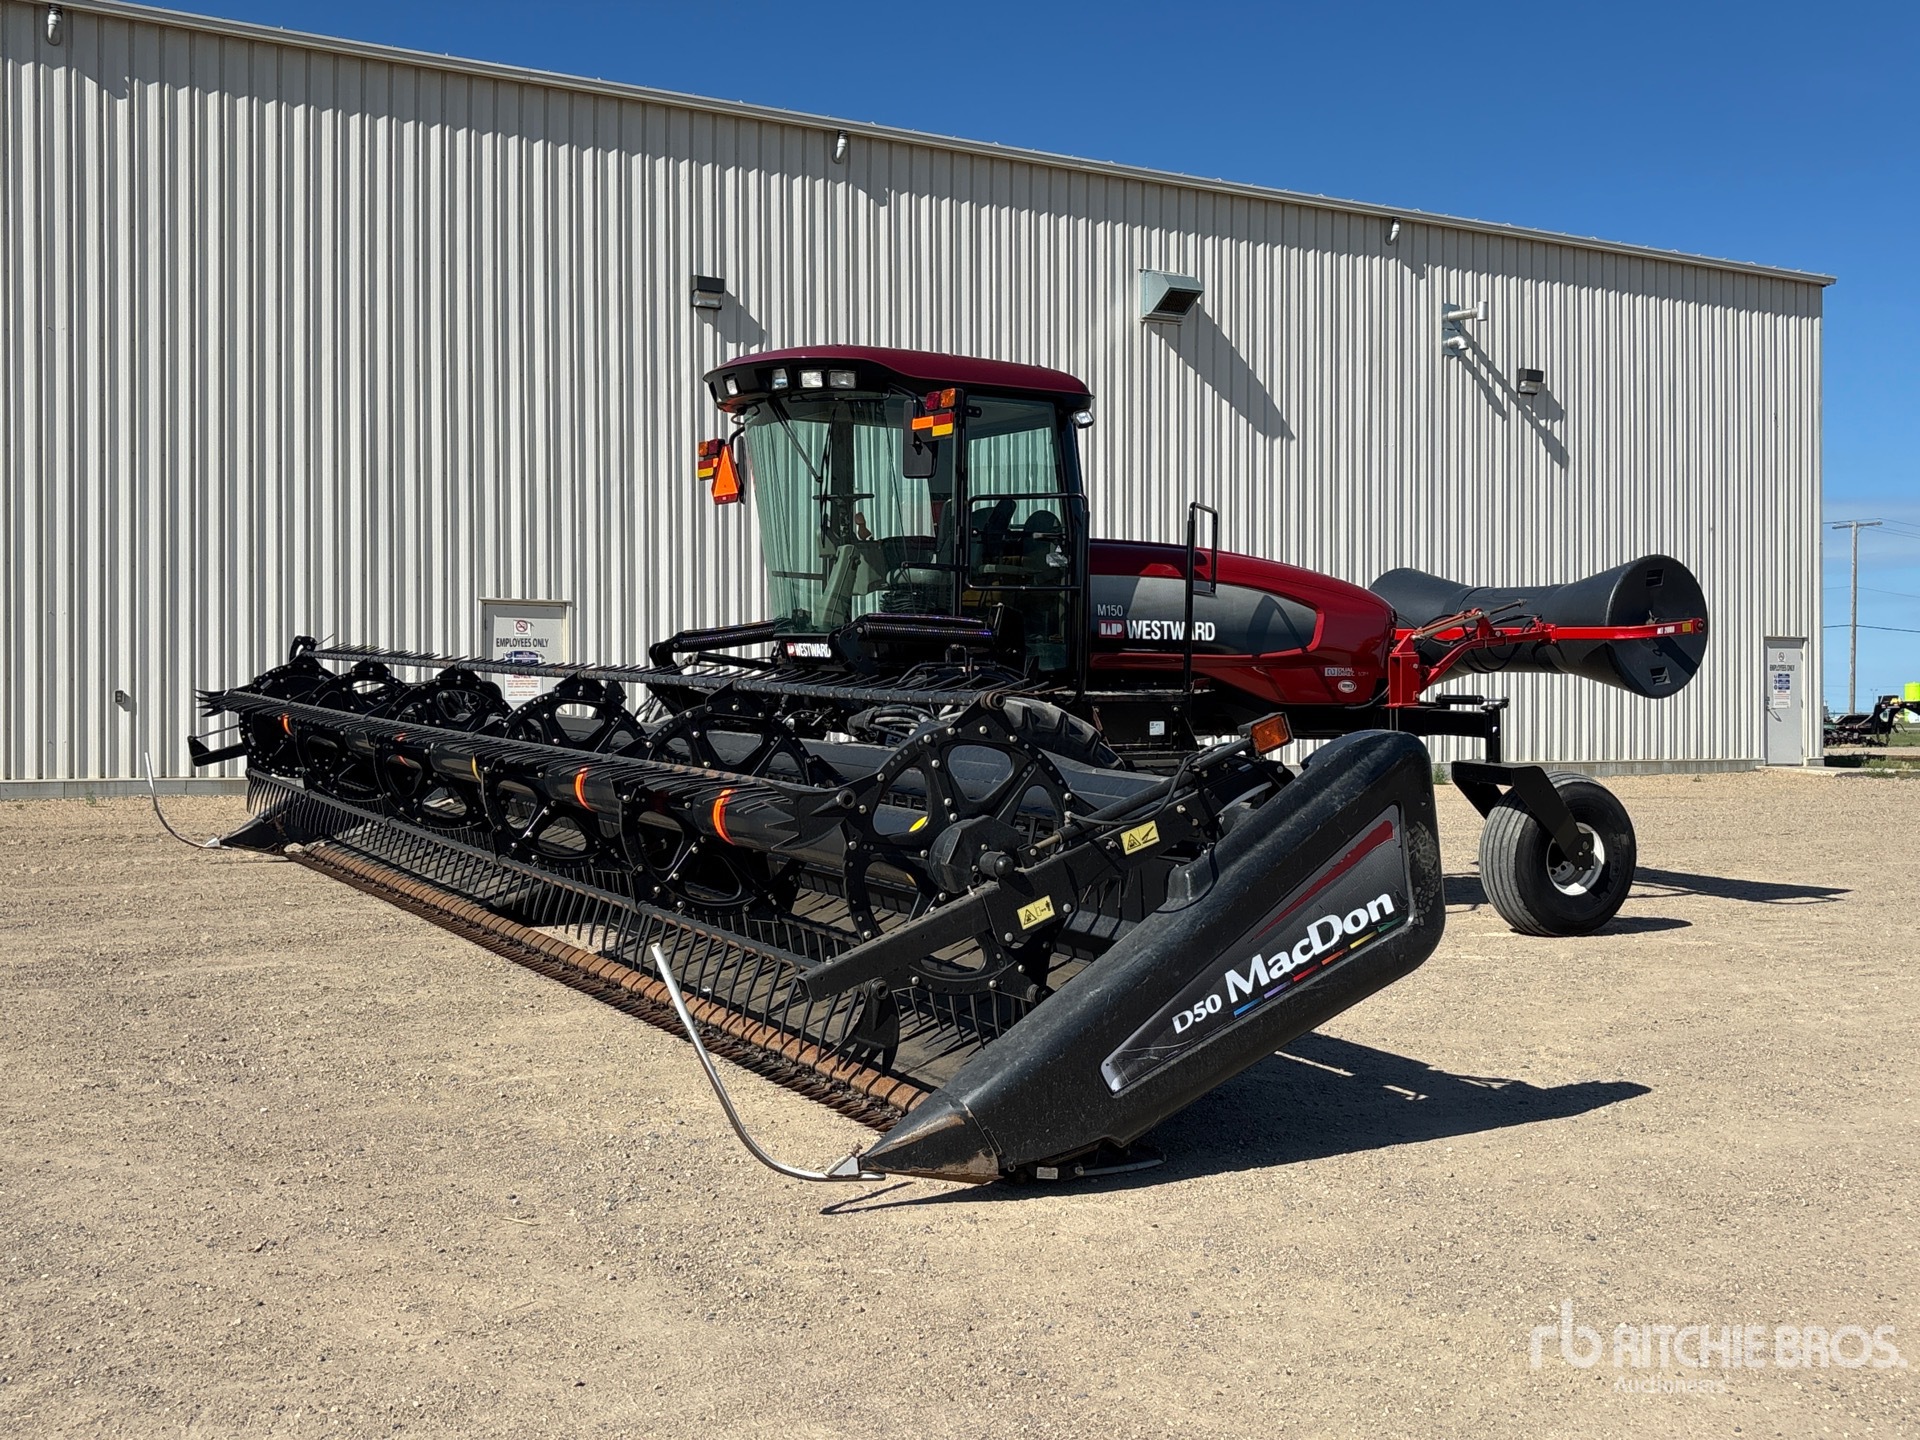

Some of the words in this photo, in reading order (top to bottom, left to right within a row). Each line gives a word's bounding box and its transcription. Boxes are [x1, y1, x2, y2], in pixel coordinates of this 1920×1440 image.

[1097, 604, 1123, 617] M150
[1126, 620, 1216, 641] WESTWRD
[496, 637, 532, 648] EMPLOYEES
[532, 637, 549, 648] ONLY
[795, 643, 831, 657] WESTWARD
[1171, 994, 1222, 1034] D50
[1224, 893, 1395, 1004] MacDon
